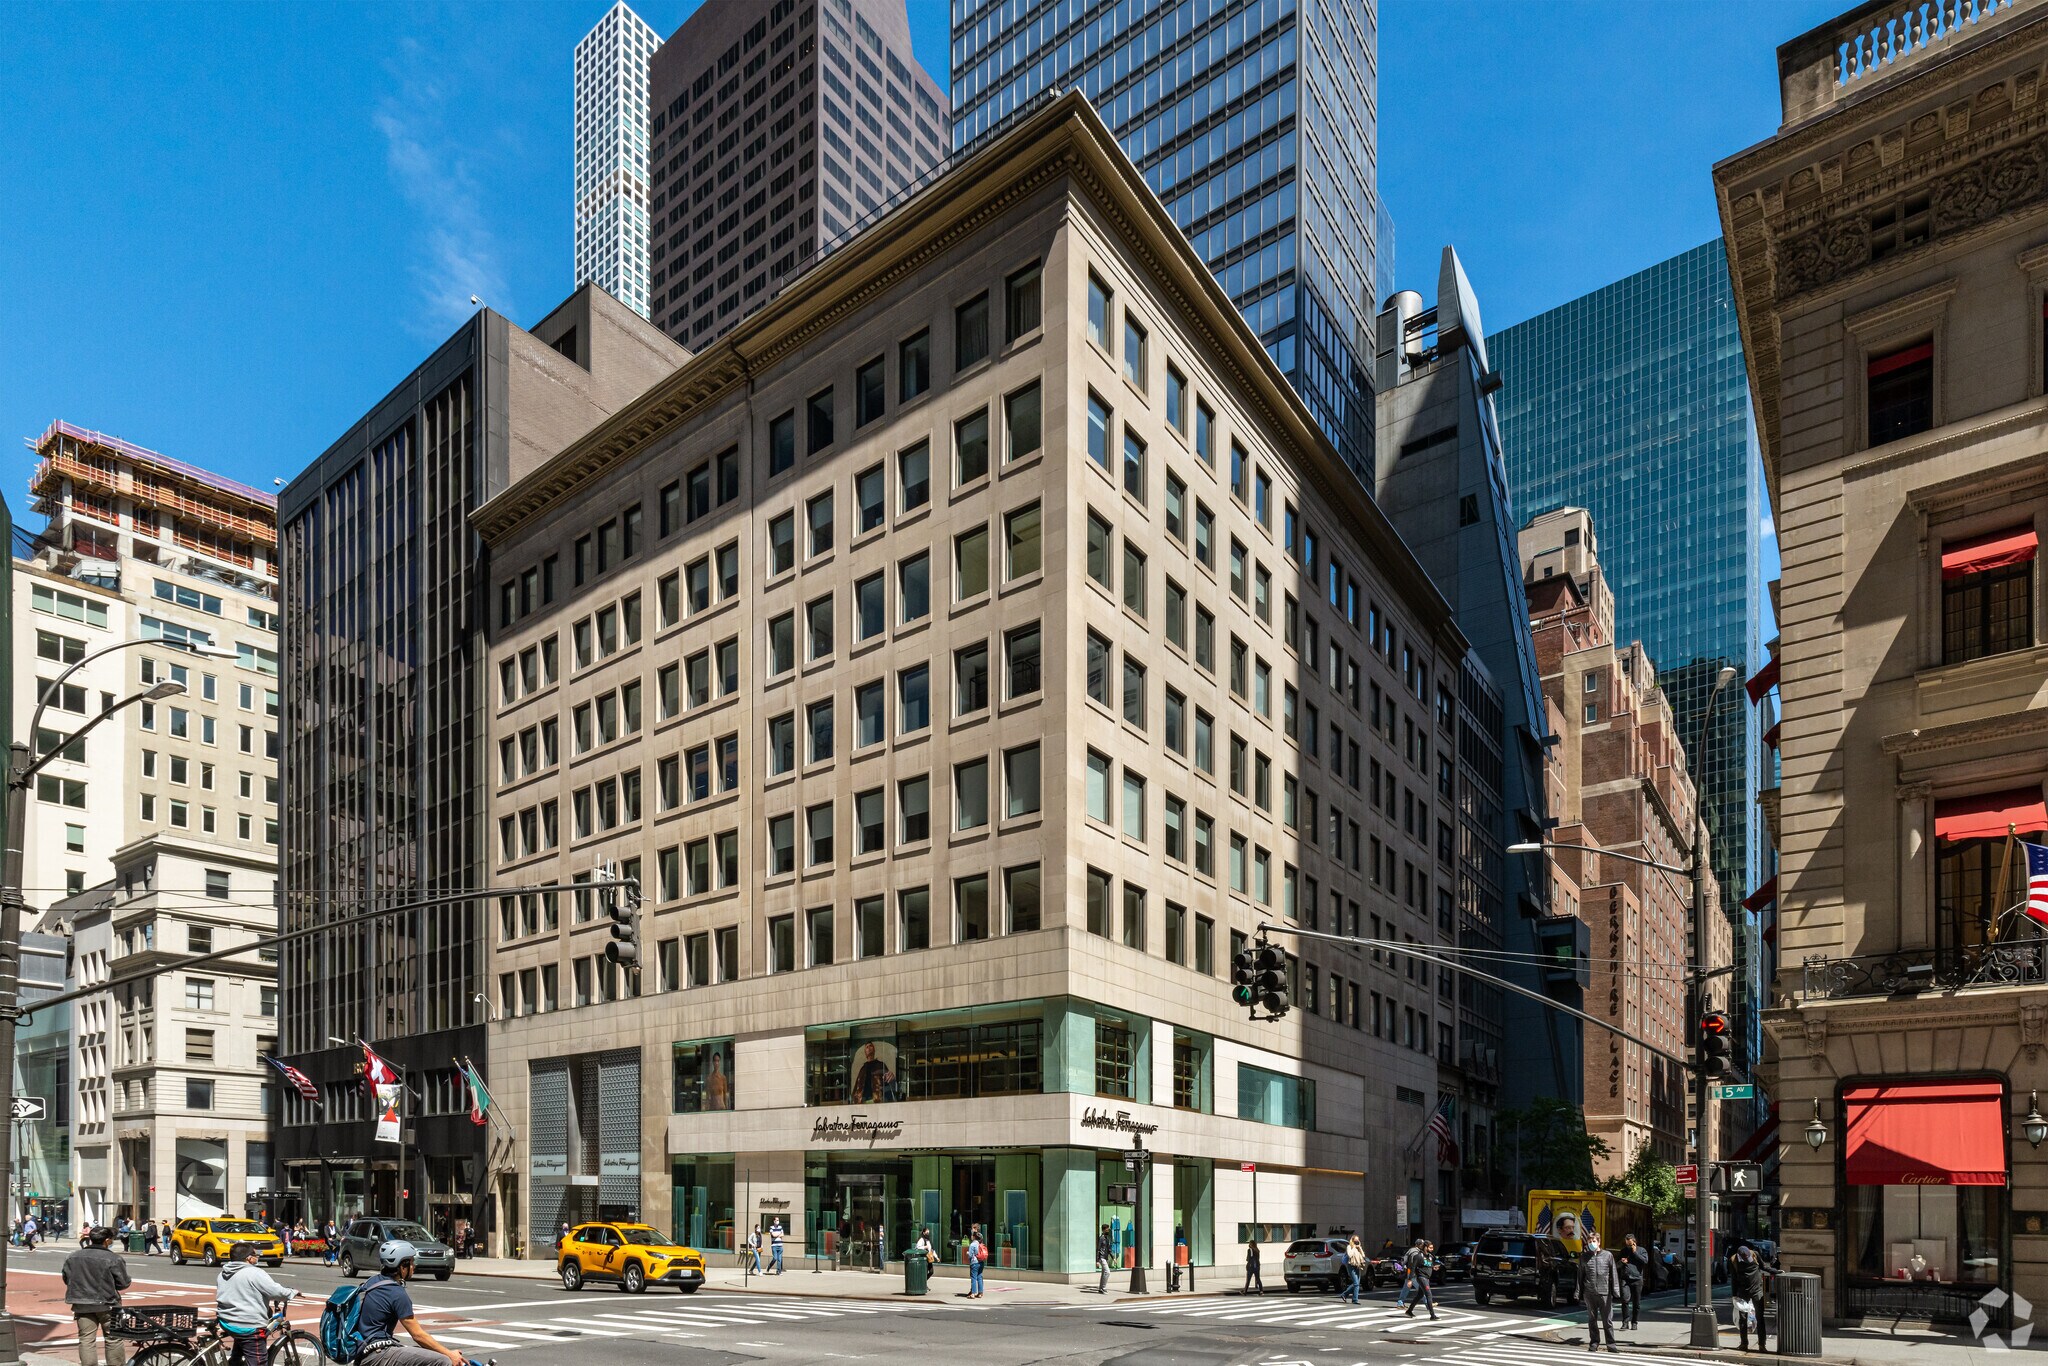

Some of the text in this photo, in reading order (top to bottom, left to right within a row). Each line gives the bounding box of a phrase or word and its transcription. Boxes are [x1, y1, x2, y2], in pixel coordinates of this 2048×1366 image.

[1609, 886, 1619, 1016] BERKSHIRE
[1725, 1086, 1734, 1098] 5
[11, 1103, 31, 1112] AY
[813, 1114, 904, 1139] Salvatore Ferragamo
[1081, 1107, 1159, 1136] Salvatore Ferragamo
[1901, 1173, 1945, 1184] Cartier
